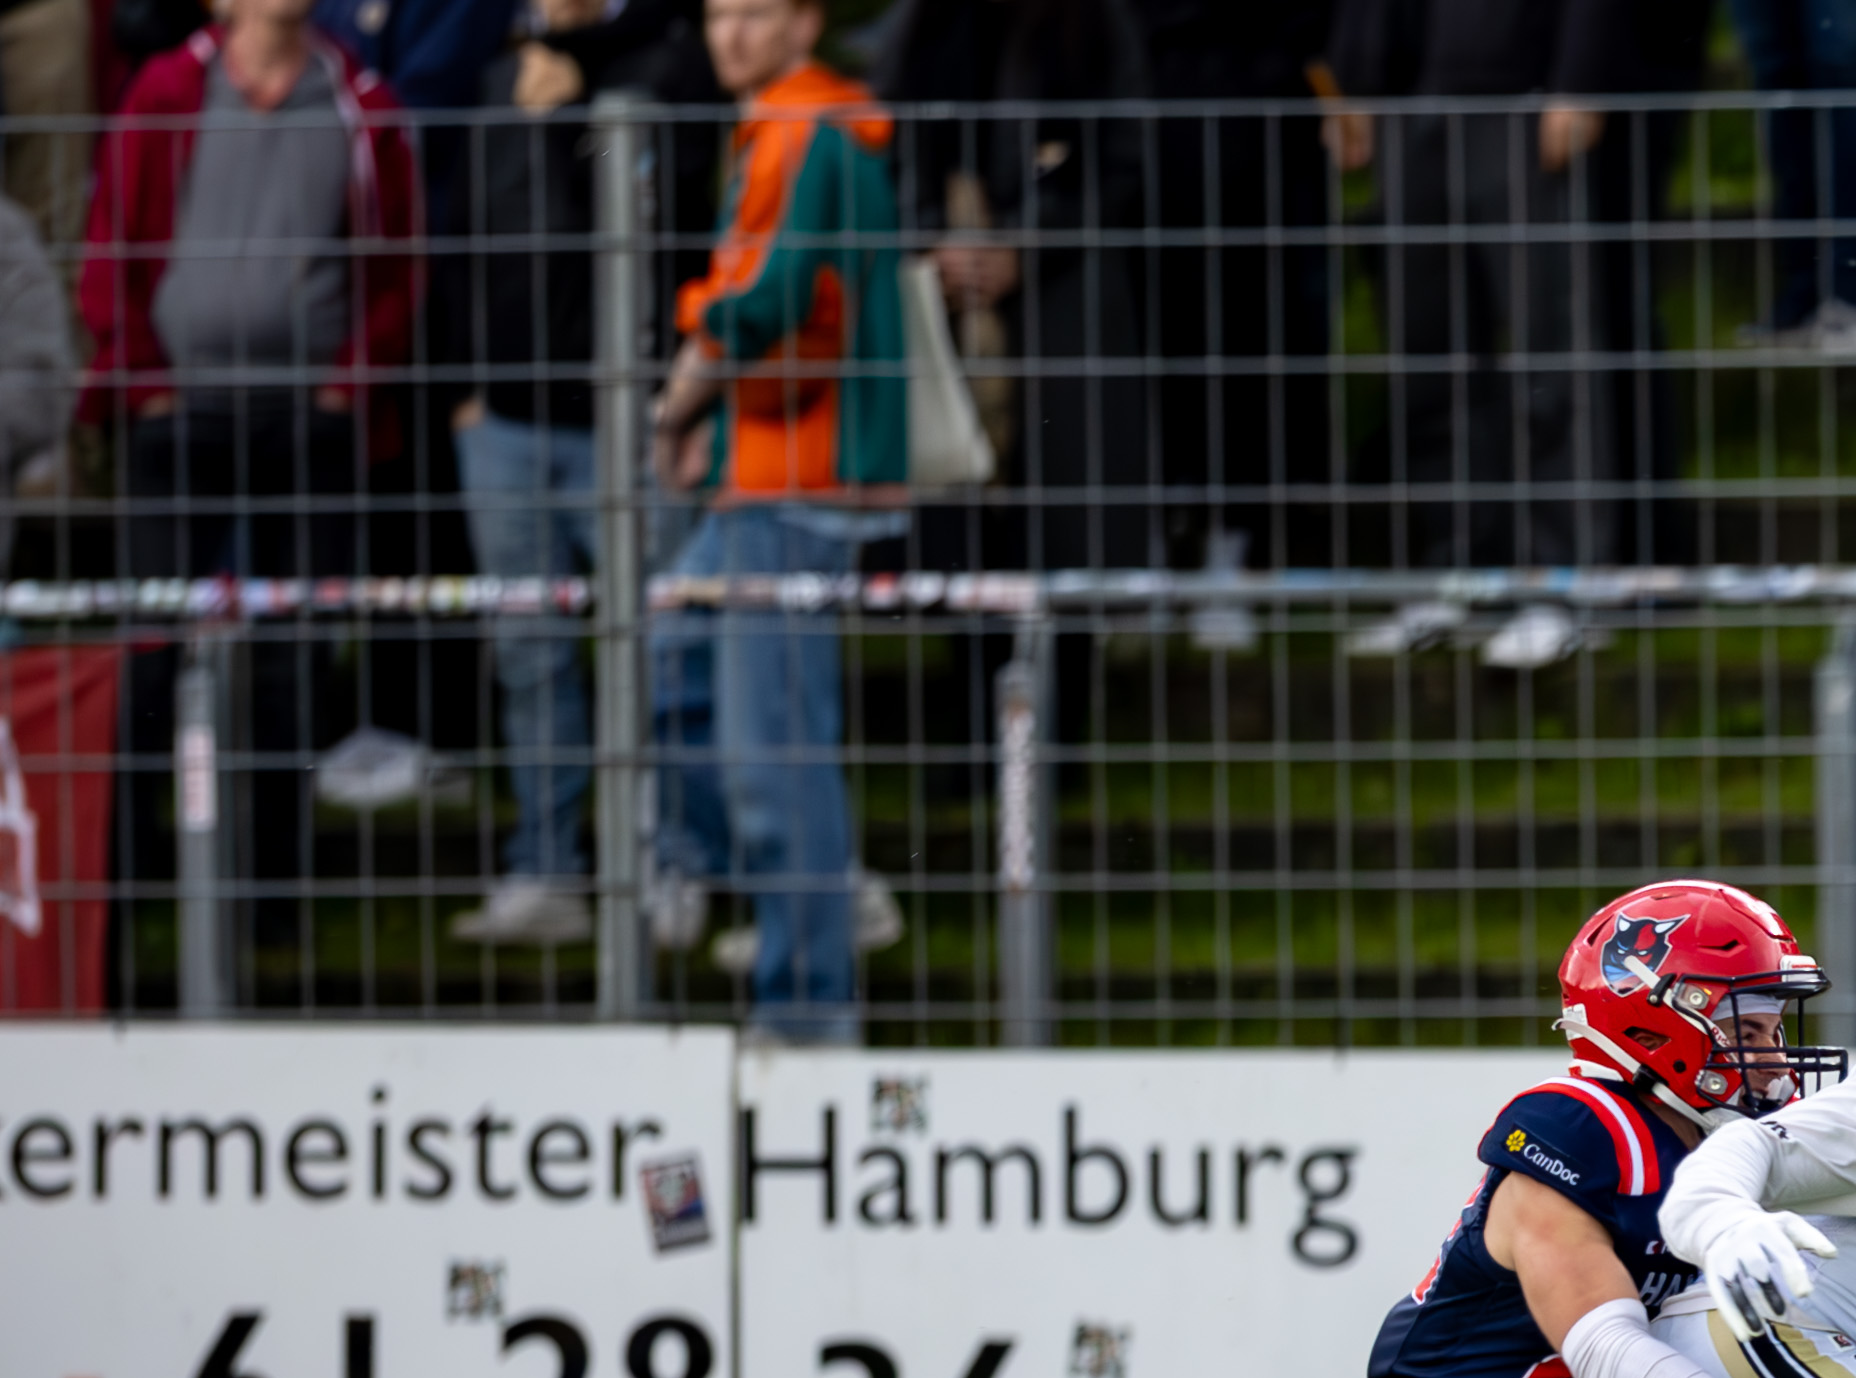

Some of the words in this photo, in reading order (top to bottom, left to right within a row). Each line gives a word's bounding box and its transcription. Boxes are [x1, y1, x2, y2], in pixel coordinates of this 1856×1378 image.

[0, 1084, 663, 1203] ermeister
[740, 1099, 1362, 1268] Hamburg
[1523, 1143, 1580, 1186] CanDoc
